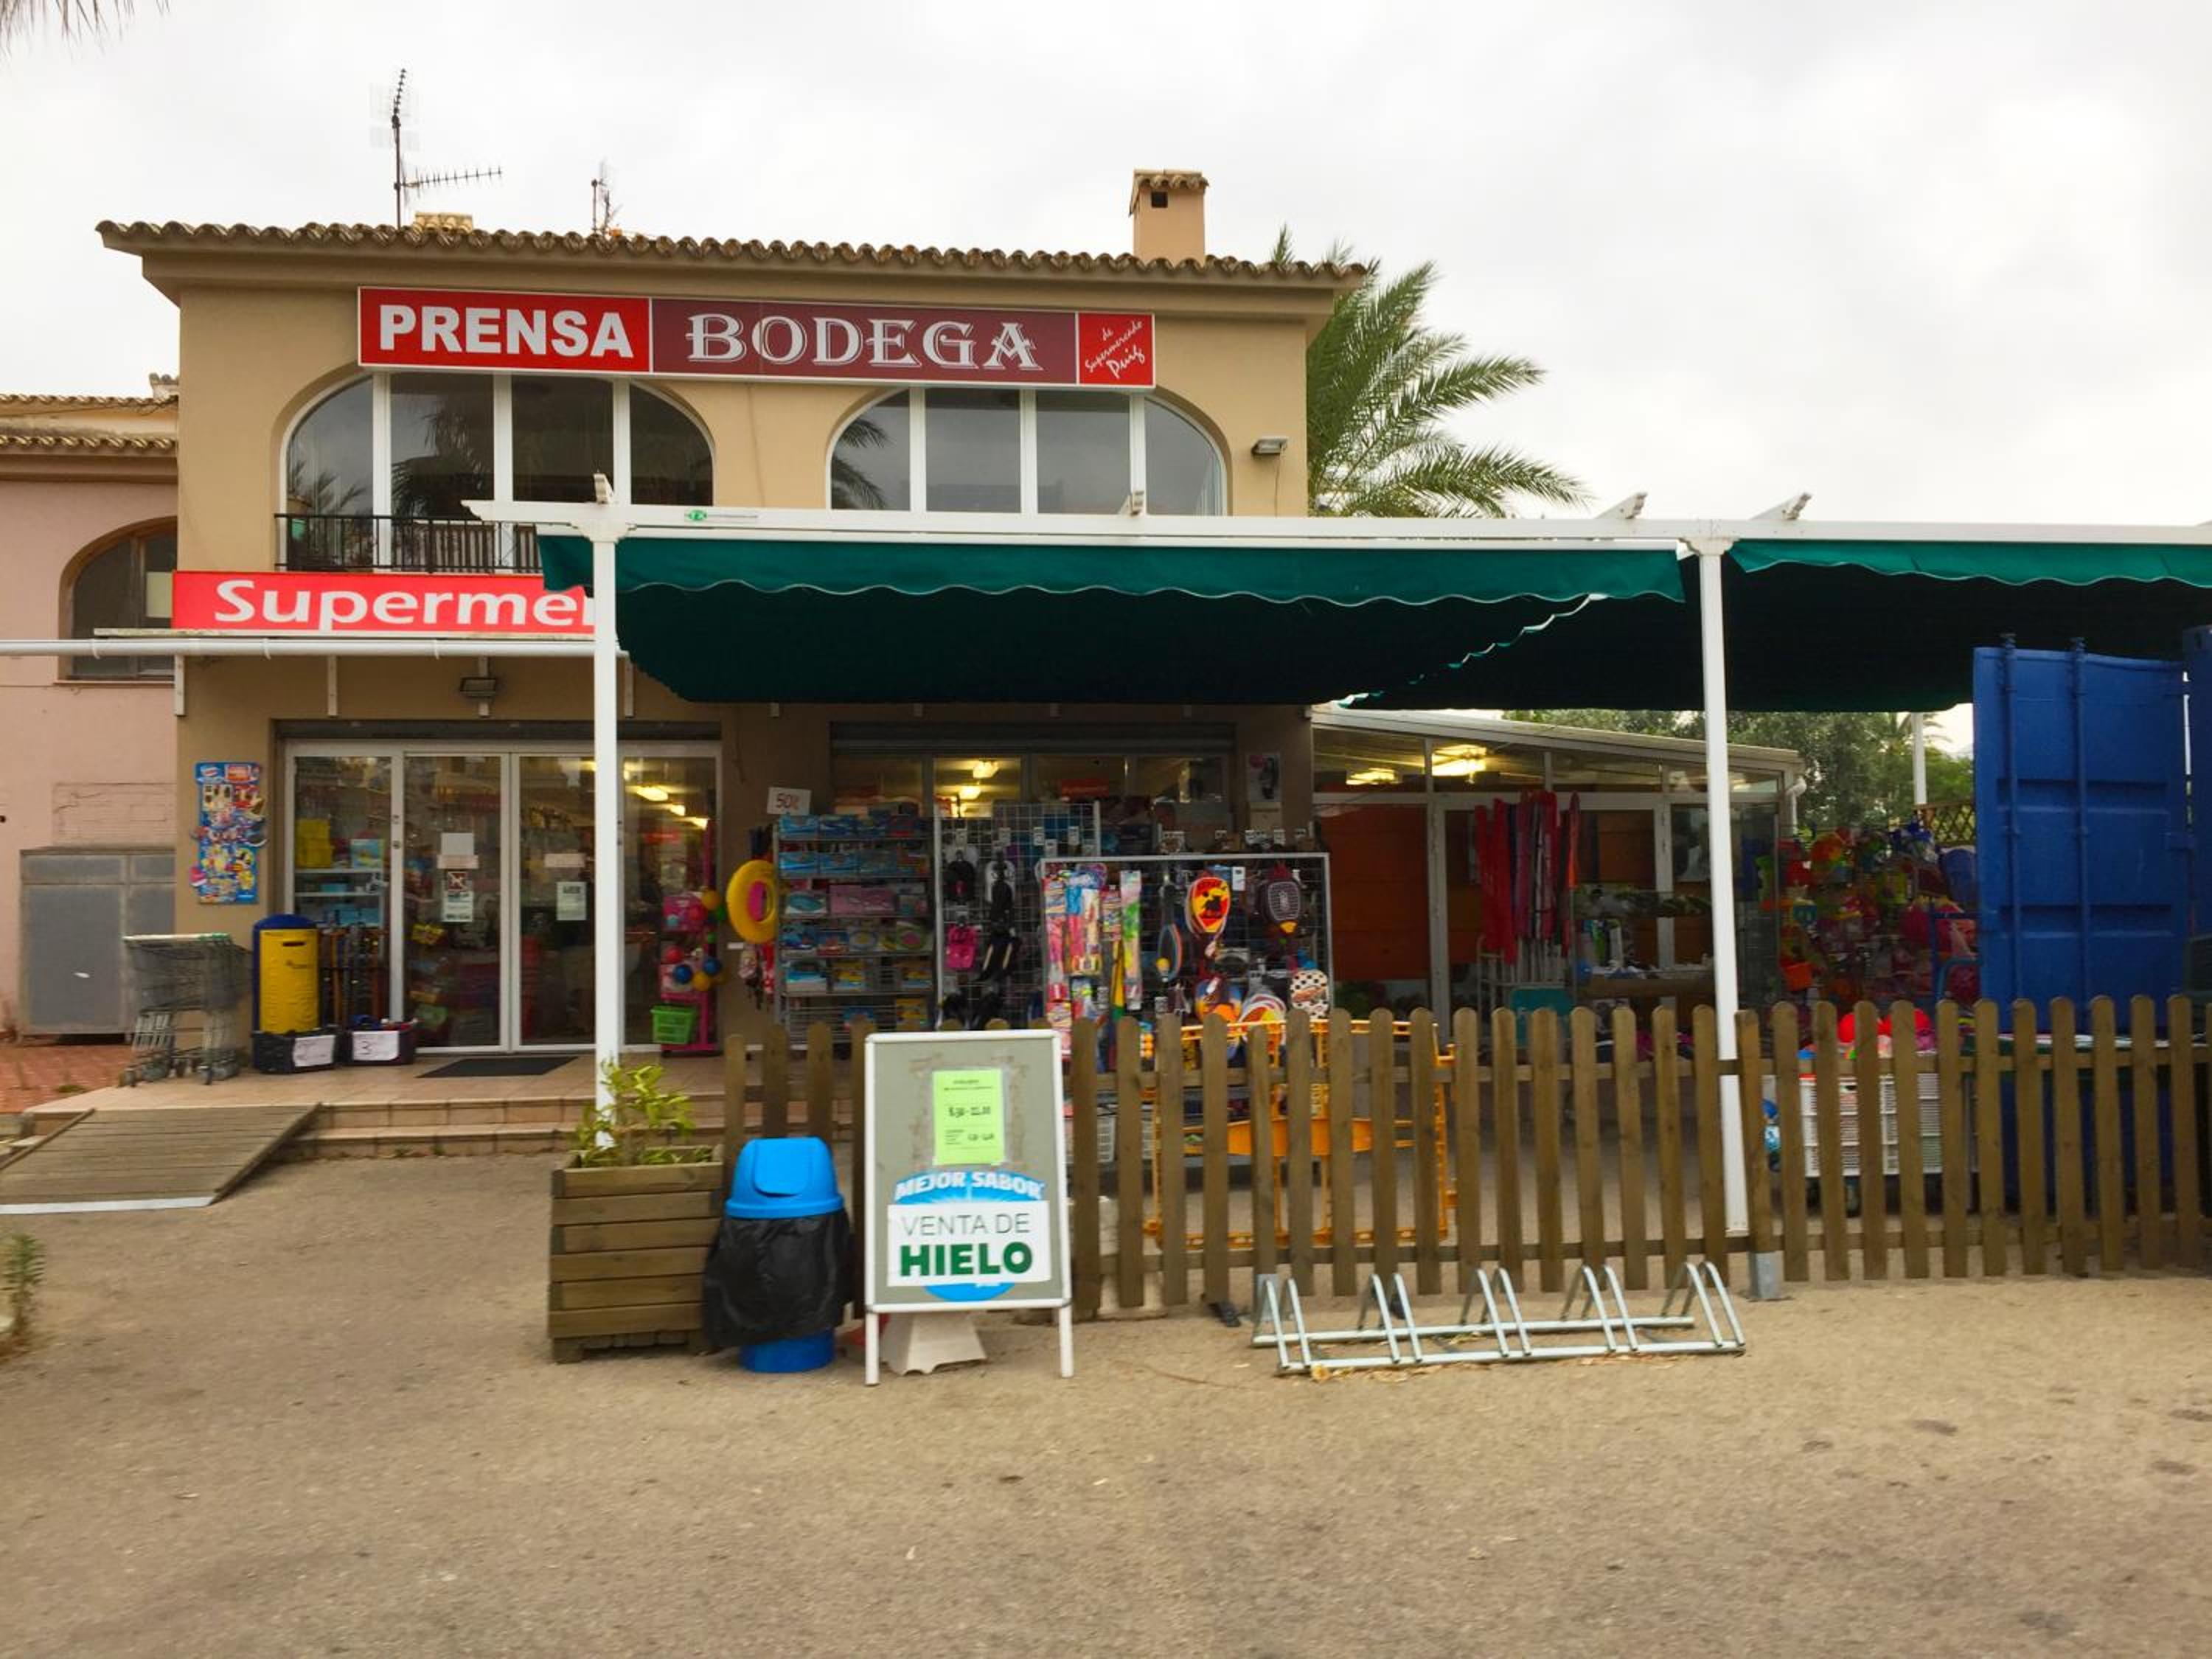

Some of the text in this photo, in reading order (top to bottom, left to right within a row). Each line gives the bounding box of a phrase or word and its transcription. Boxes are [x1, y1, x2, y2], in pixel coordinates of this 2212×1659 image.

[379, 304, 634, 358] PRENSA
[685, 313, 1044, 371] BODEGA
[894, 1171, 1043, 1200] MEJOR SABOR
[900, 1212, 1031, 1237] VENTA DE
[899, 1240, 1033, 1277] HIELO
